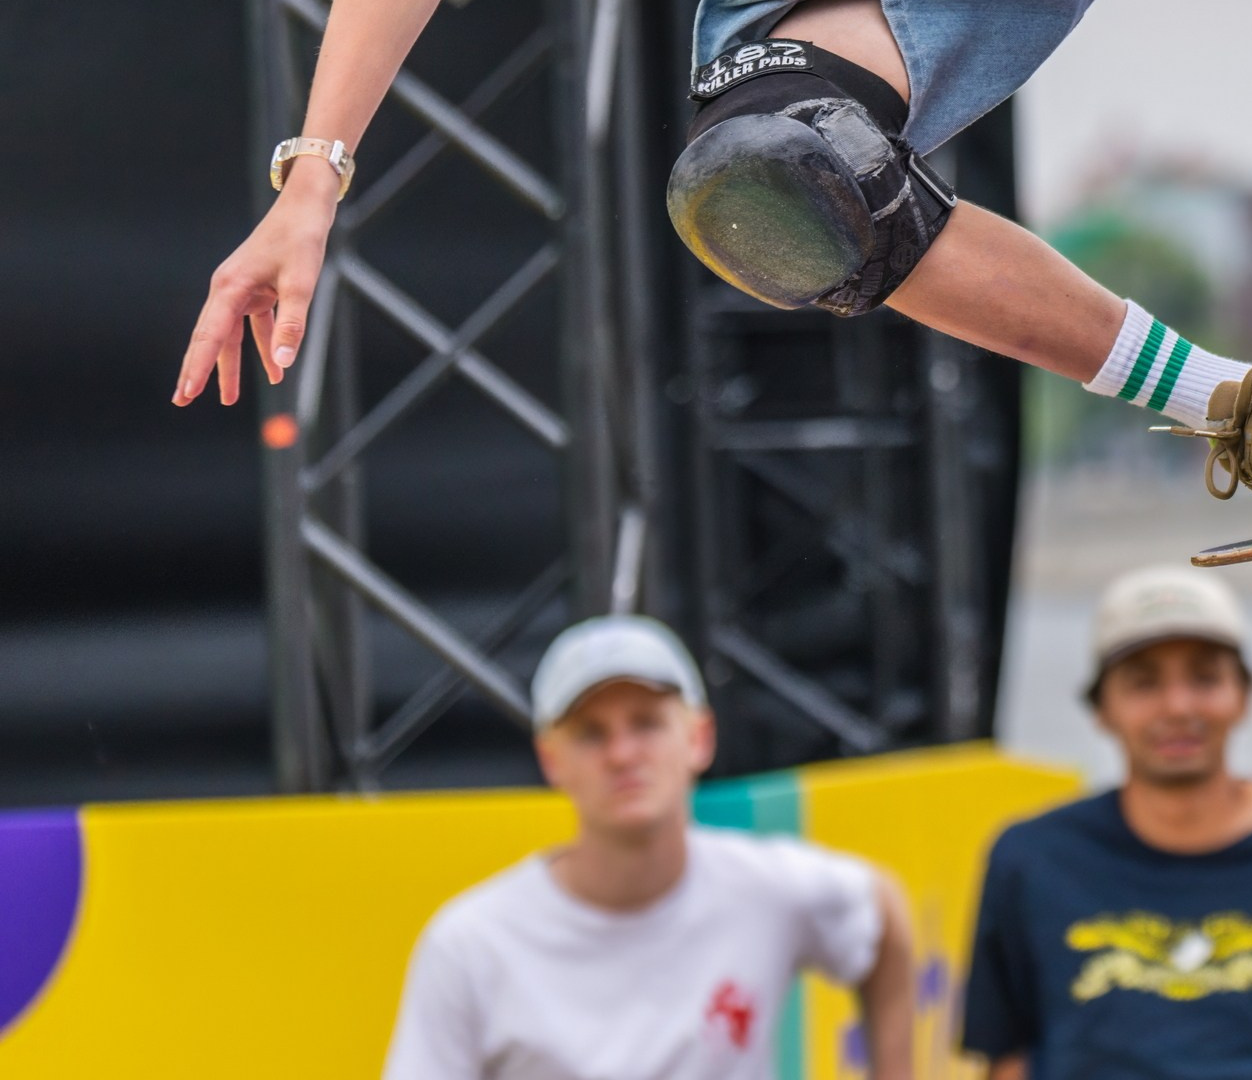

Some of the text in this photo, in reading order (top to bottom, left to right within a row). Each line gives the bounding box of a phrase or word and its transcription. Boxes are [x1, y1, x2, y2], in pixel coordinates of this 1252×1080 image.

[697, 56, 807, 93] KILLER PADS
[708, 42, 803, 81] 187
